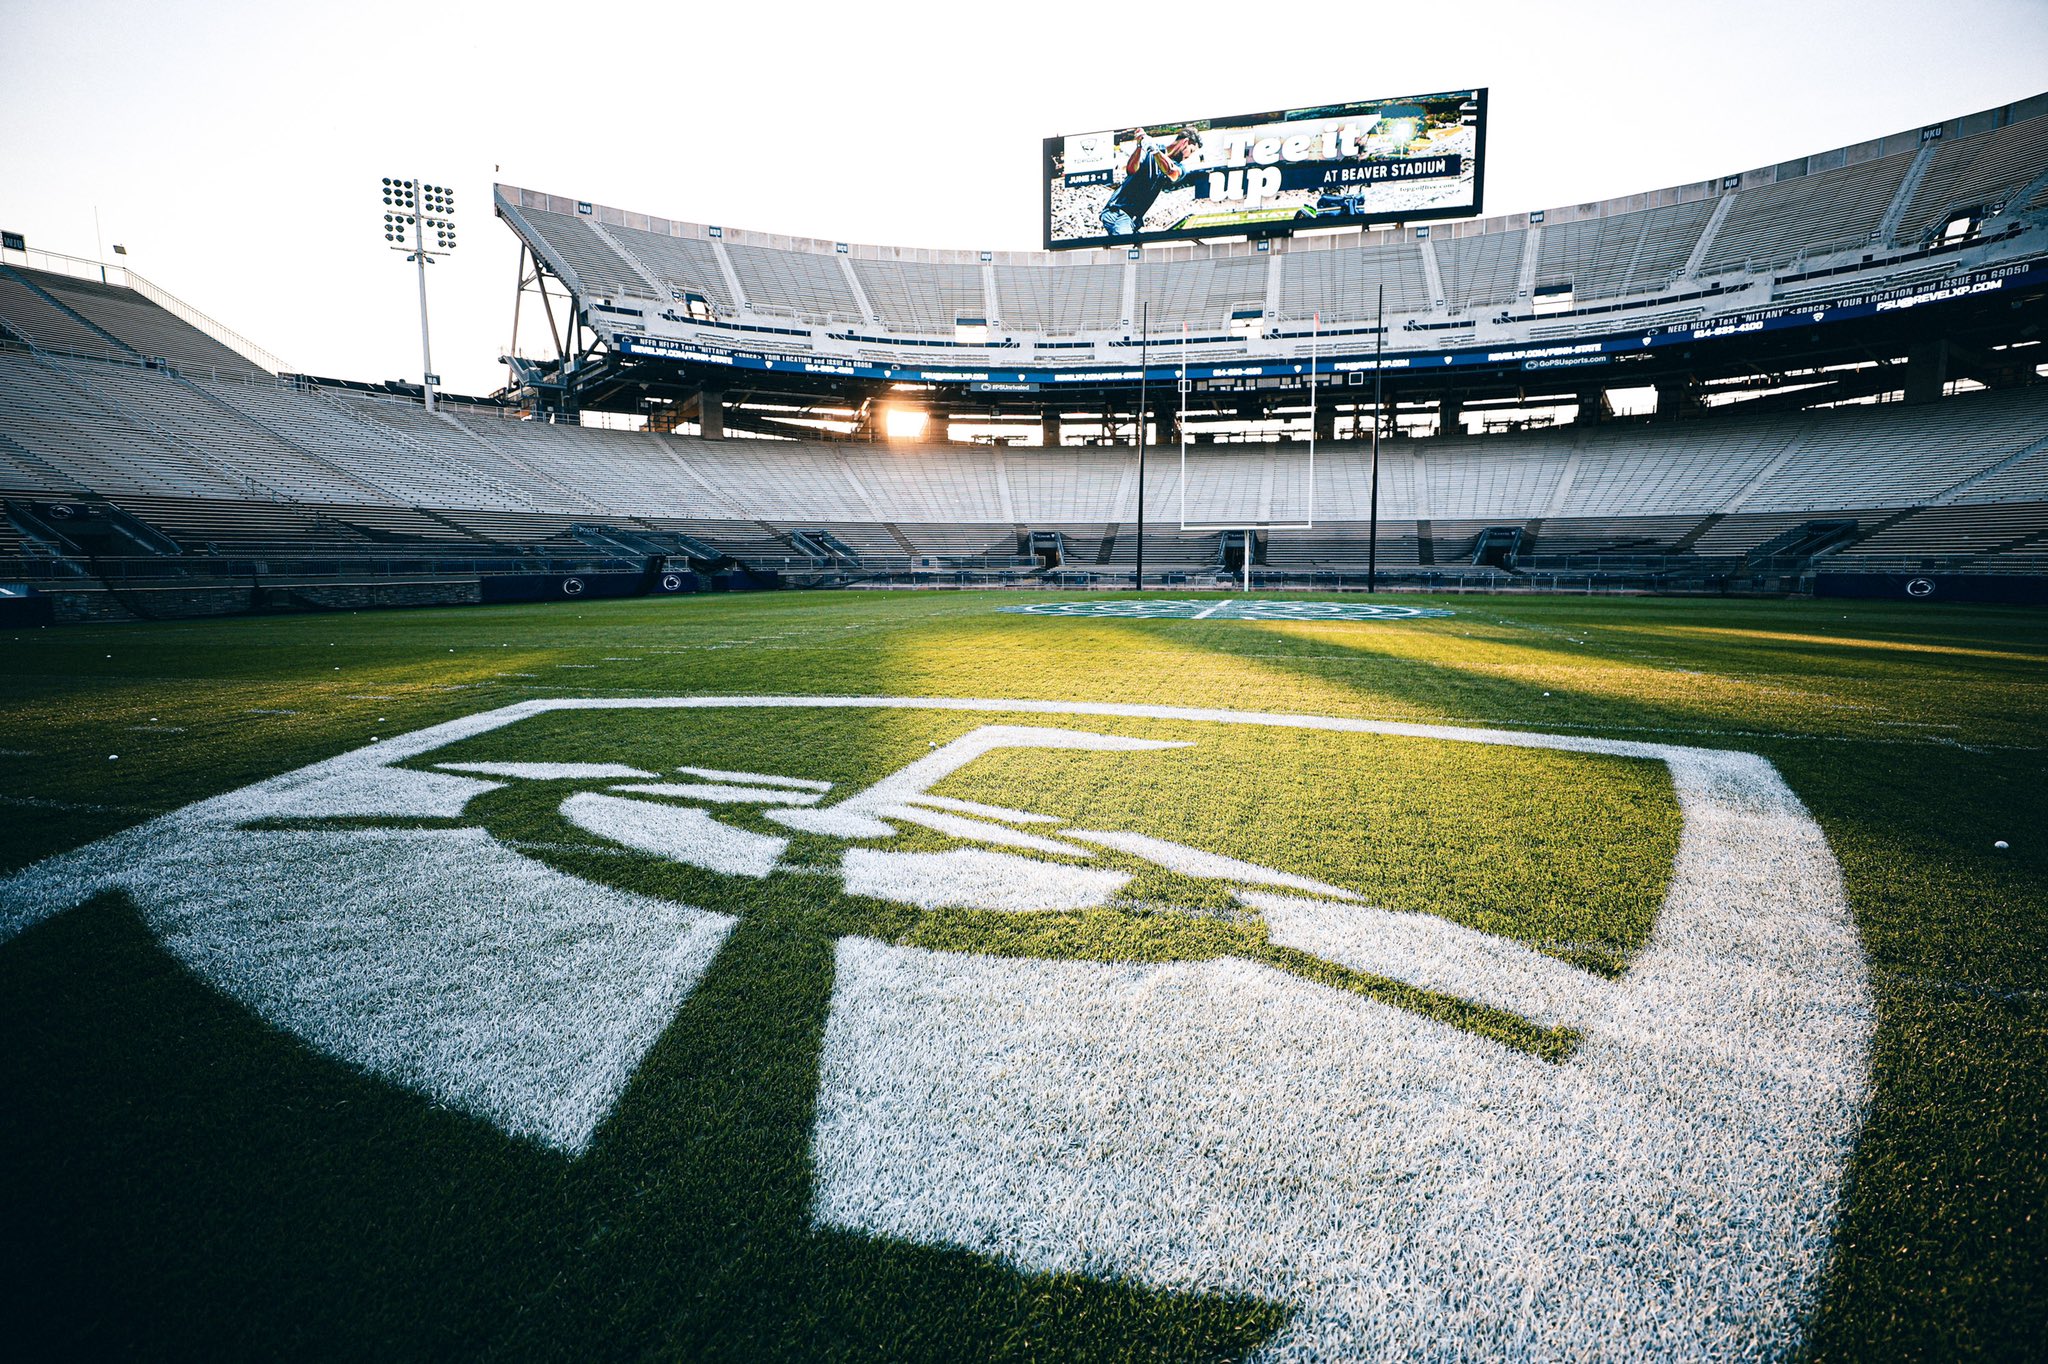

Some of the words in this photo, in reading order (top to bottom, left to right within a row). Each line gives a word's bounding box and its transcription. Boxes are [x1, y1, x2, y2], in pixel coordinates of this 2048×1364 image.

[1923, 127, 1942, 139] NKU
[1223, 131, 1311, 168] Tee
[1322, 122, 1361, 158] it
[1323, 170, 1338, 182] AT
[1341, 165, 1387, 181] BEAVER
[1391, 159, 1446, 177] STADIUM
[1068, 175, 1090, 184] JUNE
[1209, 166, 1282, 210] up
[4, 237, 23, 249] WJU
[1667, 324, 1687, 334] NEED
[1690, 319, 1715, 330] HELP?
[1719, 316, 1738, 326] Text
[1741, 308, 1789, 323] "NITTANY"
[1837, 297, 1862, 309] YOUR
[1865, 287, 1914, 304] LOCATION
[1917, 282, 1936, 293] and
[1939, 275, 1972, 289] ISSUE
[1975, 272, 1987, 282] to
[1990, 264, 2030, 279] 69050
[1876, 279, 2003, 312] PSU@REVELXP.COM
[764, 353, 781, 361] YOUR
[1539, 355, 1607, 367] GoPSUsports.com
[992, 383, 1030, 391] #PSUnrivaled
